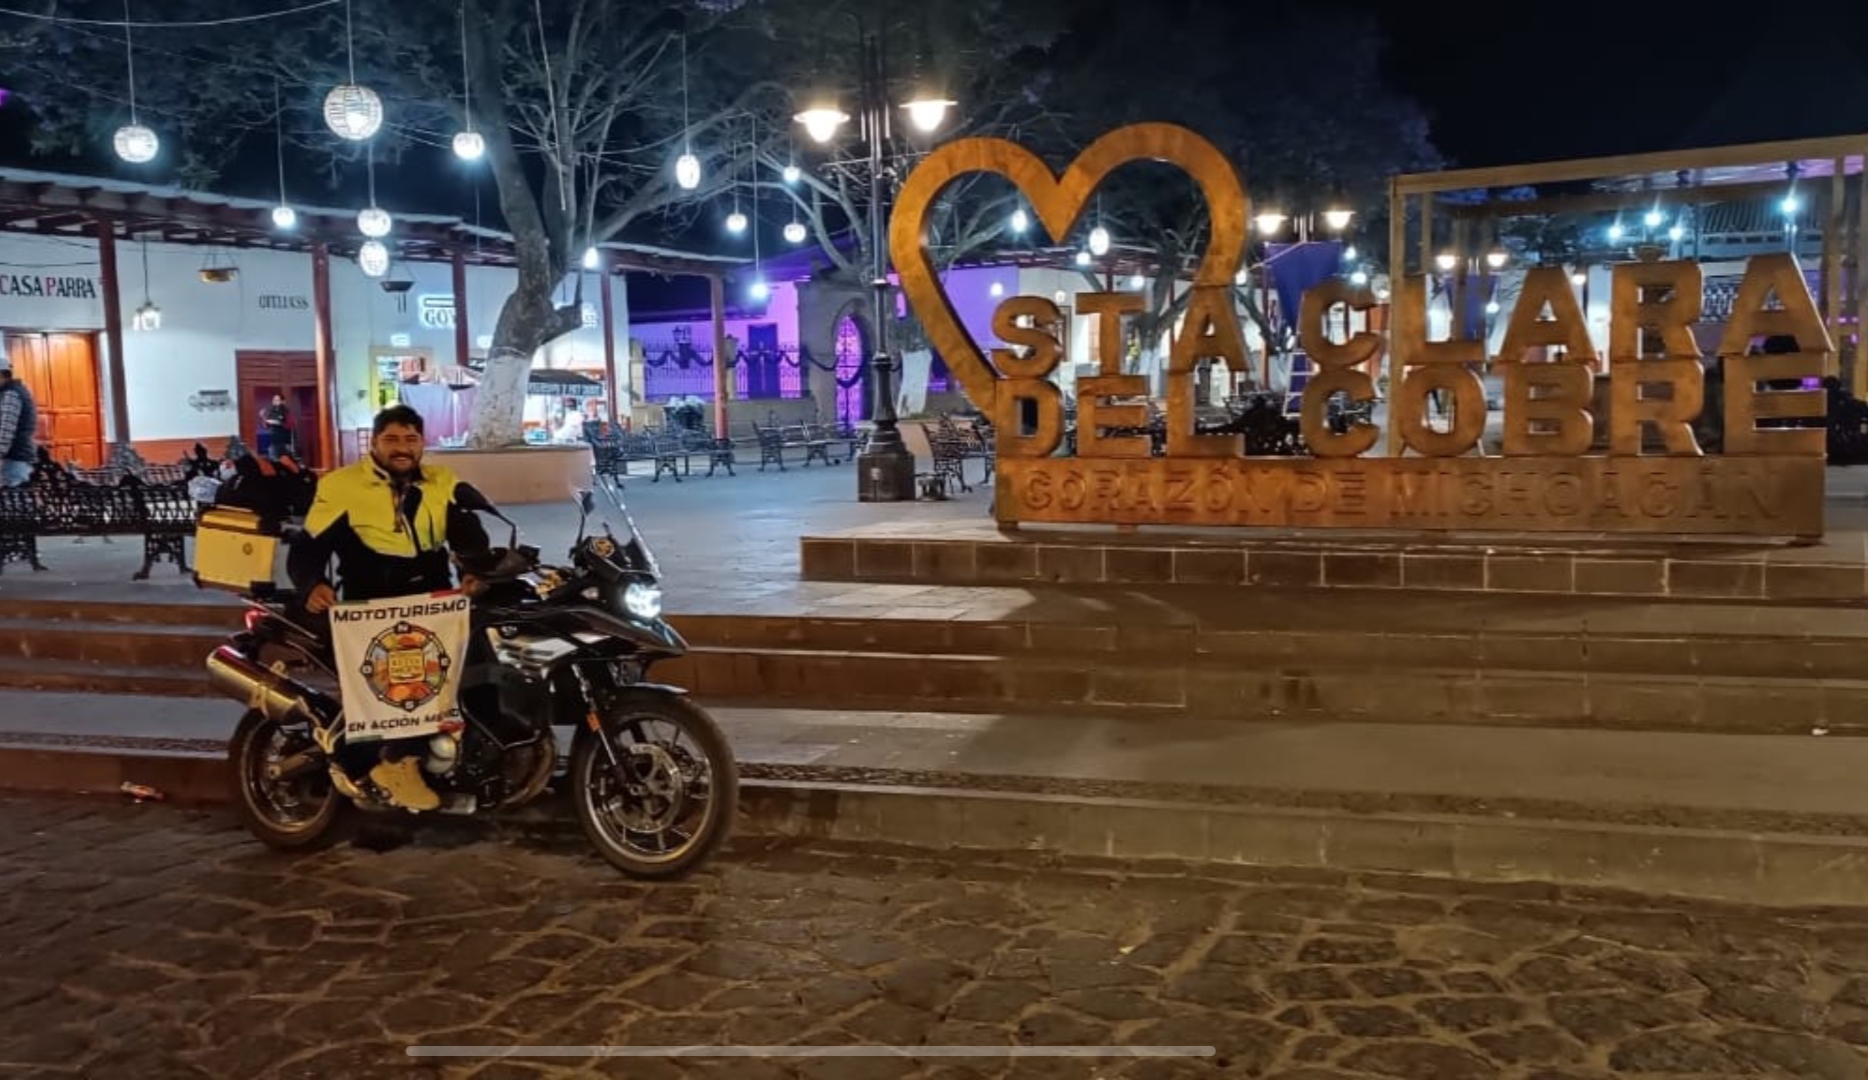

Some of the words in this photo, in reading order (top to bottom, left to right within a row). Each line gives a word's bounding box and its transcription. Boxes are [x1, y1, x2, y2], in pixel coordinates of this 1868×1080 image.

[0, 275, 43, 297] CASA
[45, 277, 96, 298] PARRA
[991, 286, 1249, 378] STA
[1303, 253, 1835, 368] CLARA
[996, 374, 1246, 458] DEL
[1301, 353, 1828, 458] COBRE
[1026, 464, 1275, 514] CORAZÓN
[1292, 470, 1367, 515] DE
[334, 600, 466, 622] MOTOTURISMO
[348, 721, 365, 732] EN
[371, 715, 420, 730] ACCIÓN
